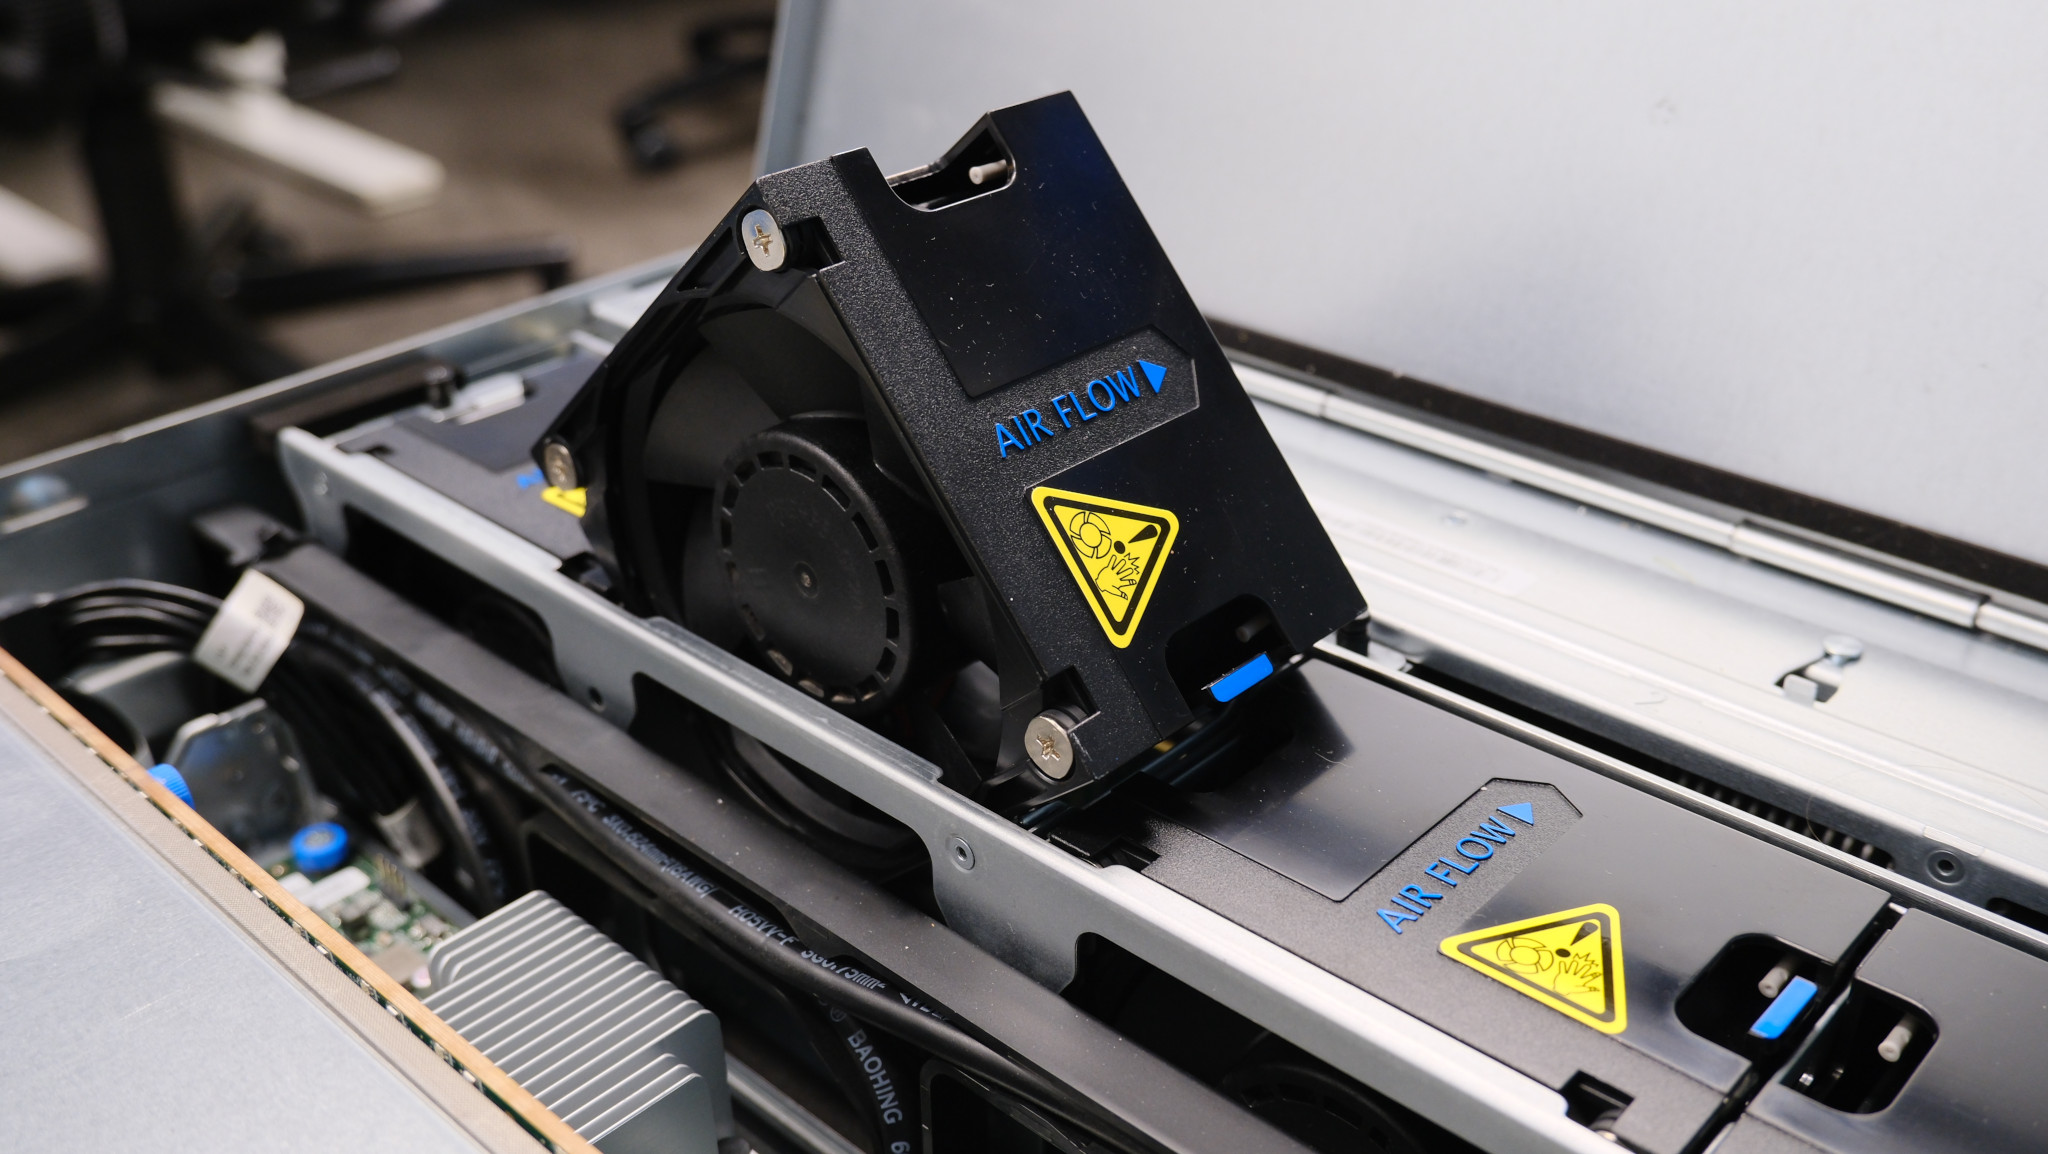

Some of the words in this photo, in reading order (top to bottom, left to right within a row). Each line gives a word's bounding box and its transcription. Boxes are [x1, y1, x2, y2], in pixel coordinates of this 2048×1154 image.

[995, 409, 1055, 458] AIR
[1051, 365, 1141, 429] FLOW
[1376, 883, 1444, 934] AIR
[1424, 815, 1516, 887] FLOW
[847, 1029, 903, 1125] BAOHING
